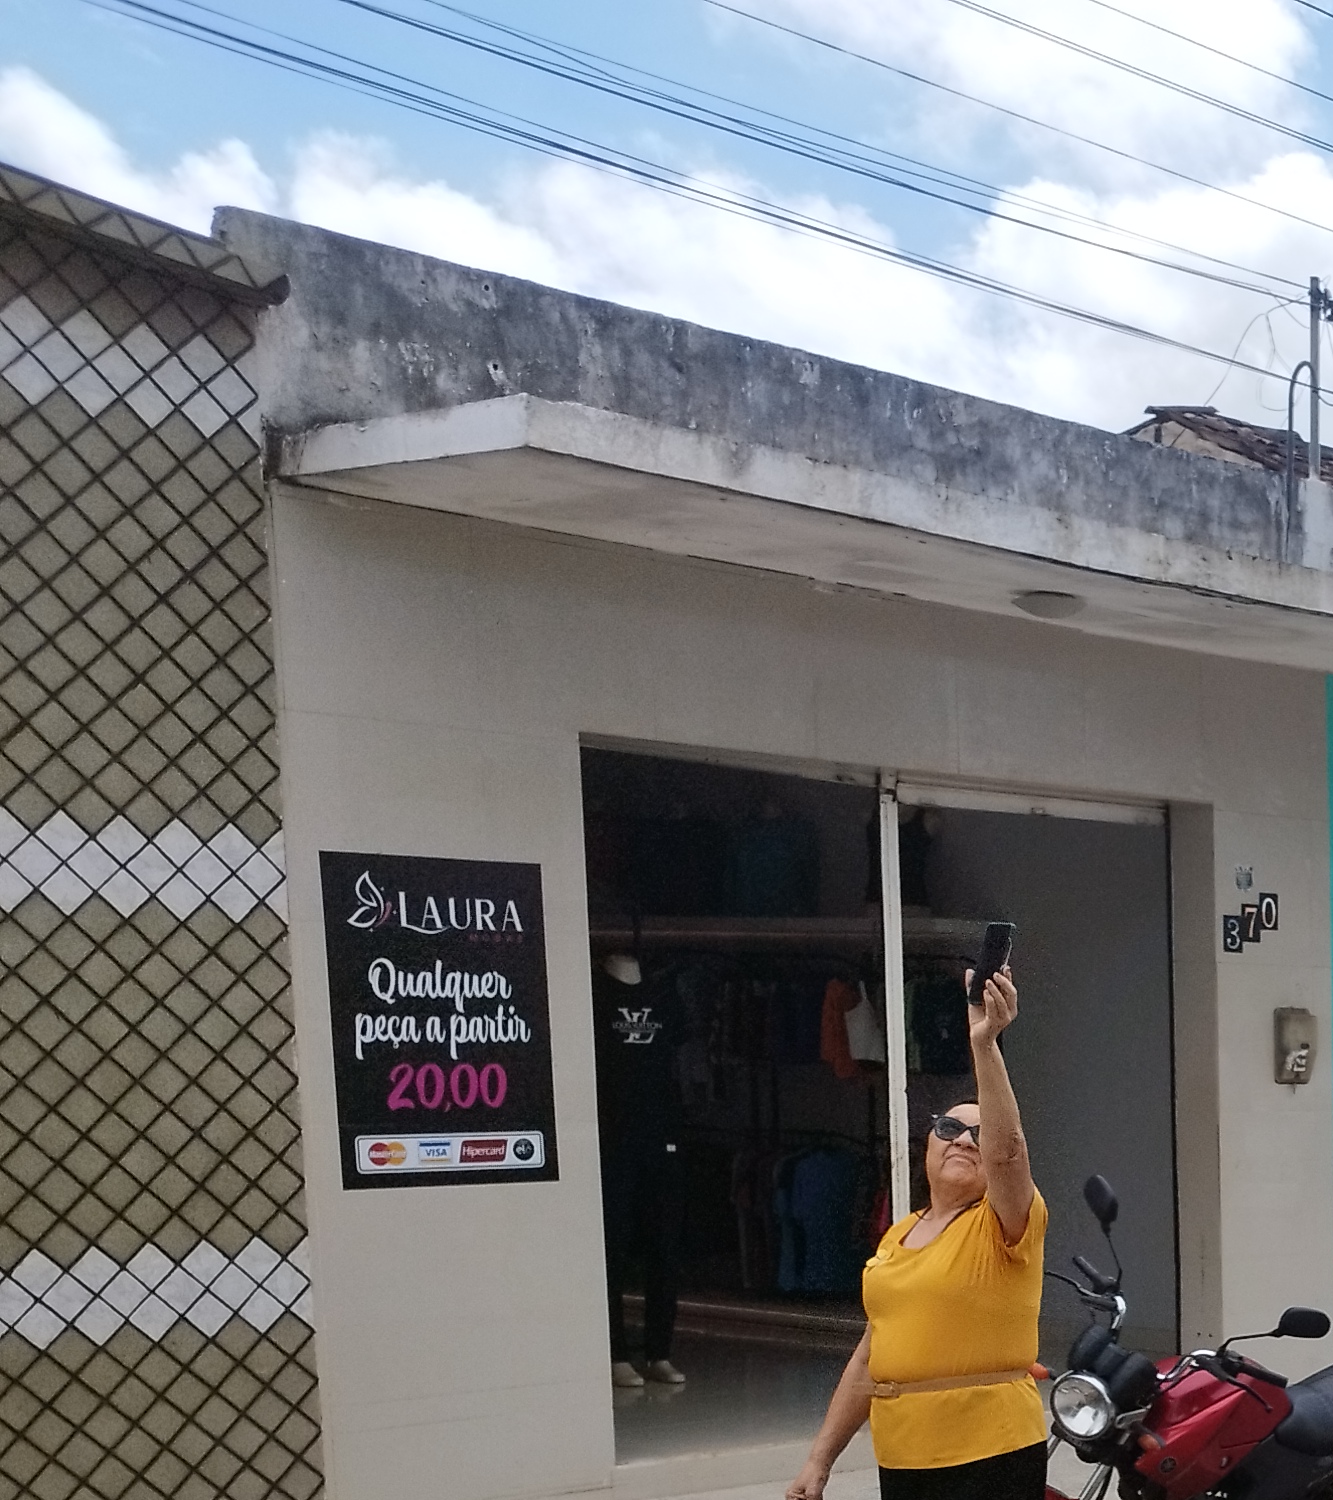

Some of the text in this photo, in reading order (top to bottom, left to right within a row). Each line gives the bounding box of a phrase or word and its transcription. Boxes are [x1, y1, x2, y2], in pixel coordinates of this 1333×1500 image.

[398, 891, 524, 935] LAURA
[1226, 897, 1277, 950] 370
[368, 957, 512, 1014] Qualquer
[355, 1004, 531, 1061] peça a partir
[386, 1063, 508, 1113] 20,00
[425, 1148, 447, 1157] VISA
[461, 1143, 506, 1160] Hipercard
